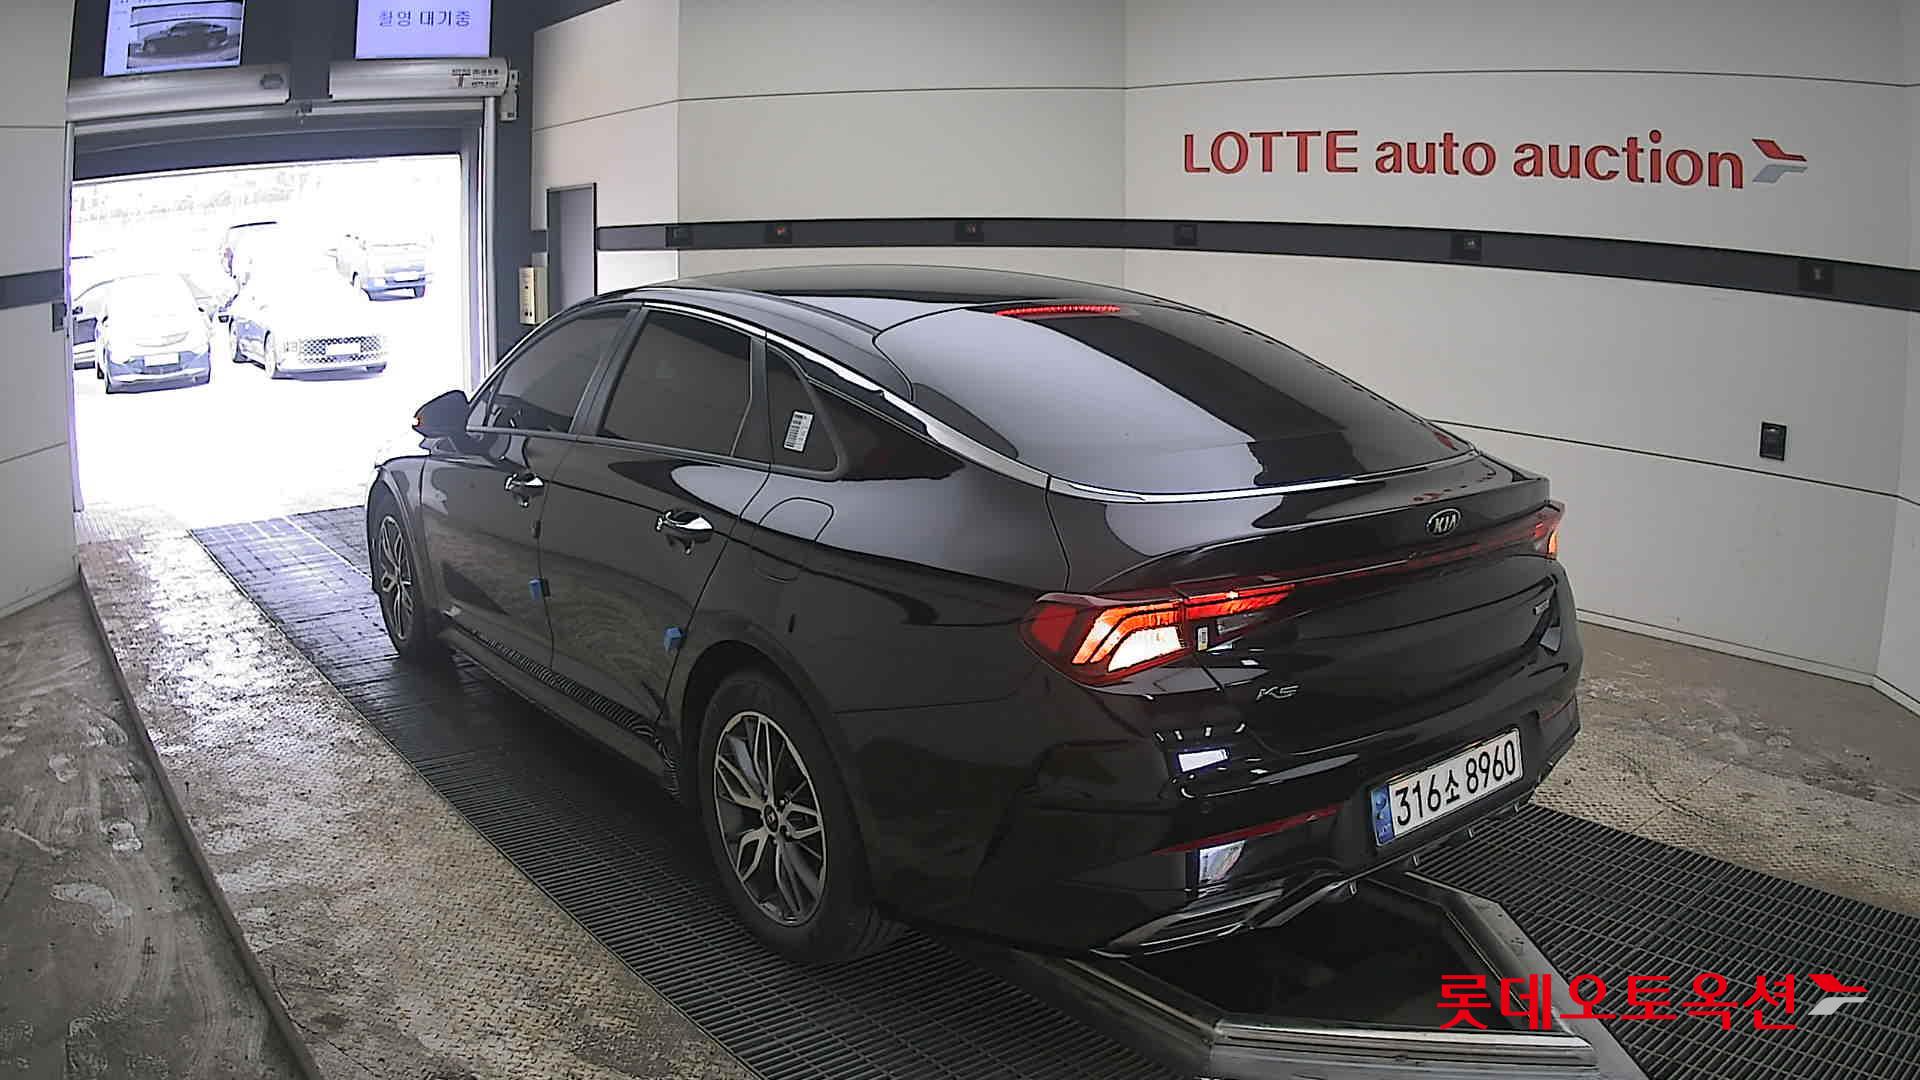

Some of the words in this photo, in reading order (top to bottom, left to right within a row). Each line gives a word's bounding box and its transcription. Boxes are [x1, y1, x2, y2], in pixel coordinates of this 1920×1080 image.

[419, 10, 471, 27] 대기중
[1184, 130, 1358, 174] LOTTE
[1375, 132, 1497, 177] auto
[1513, 130, 1745, 189] auction
[1432, 513, 1458, 534] KIA
[1256, 686, 1299, 700] K5
